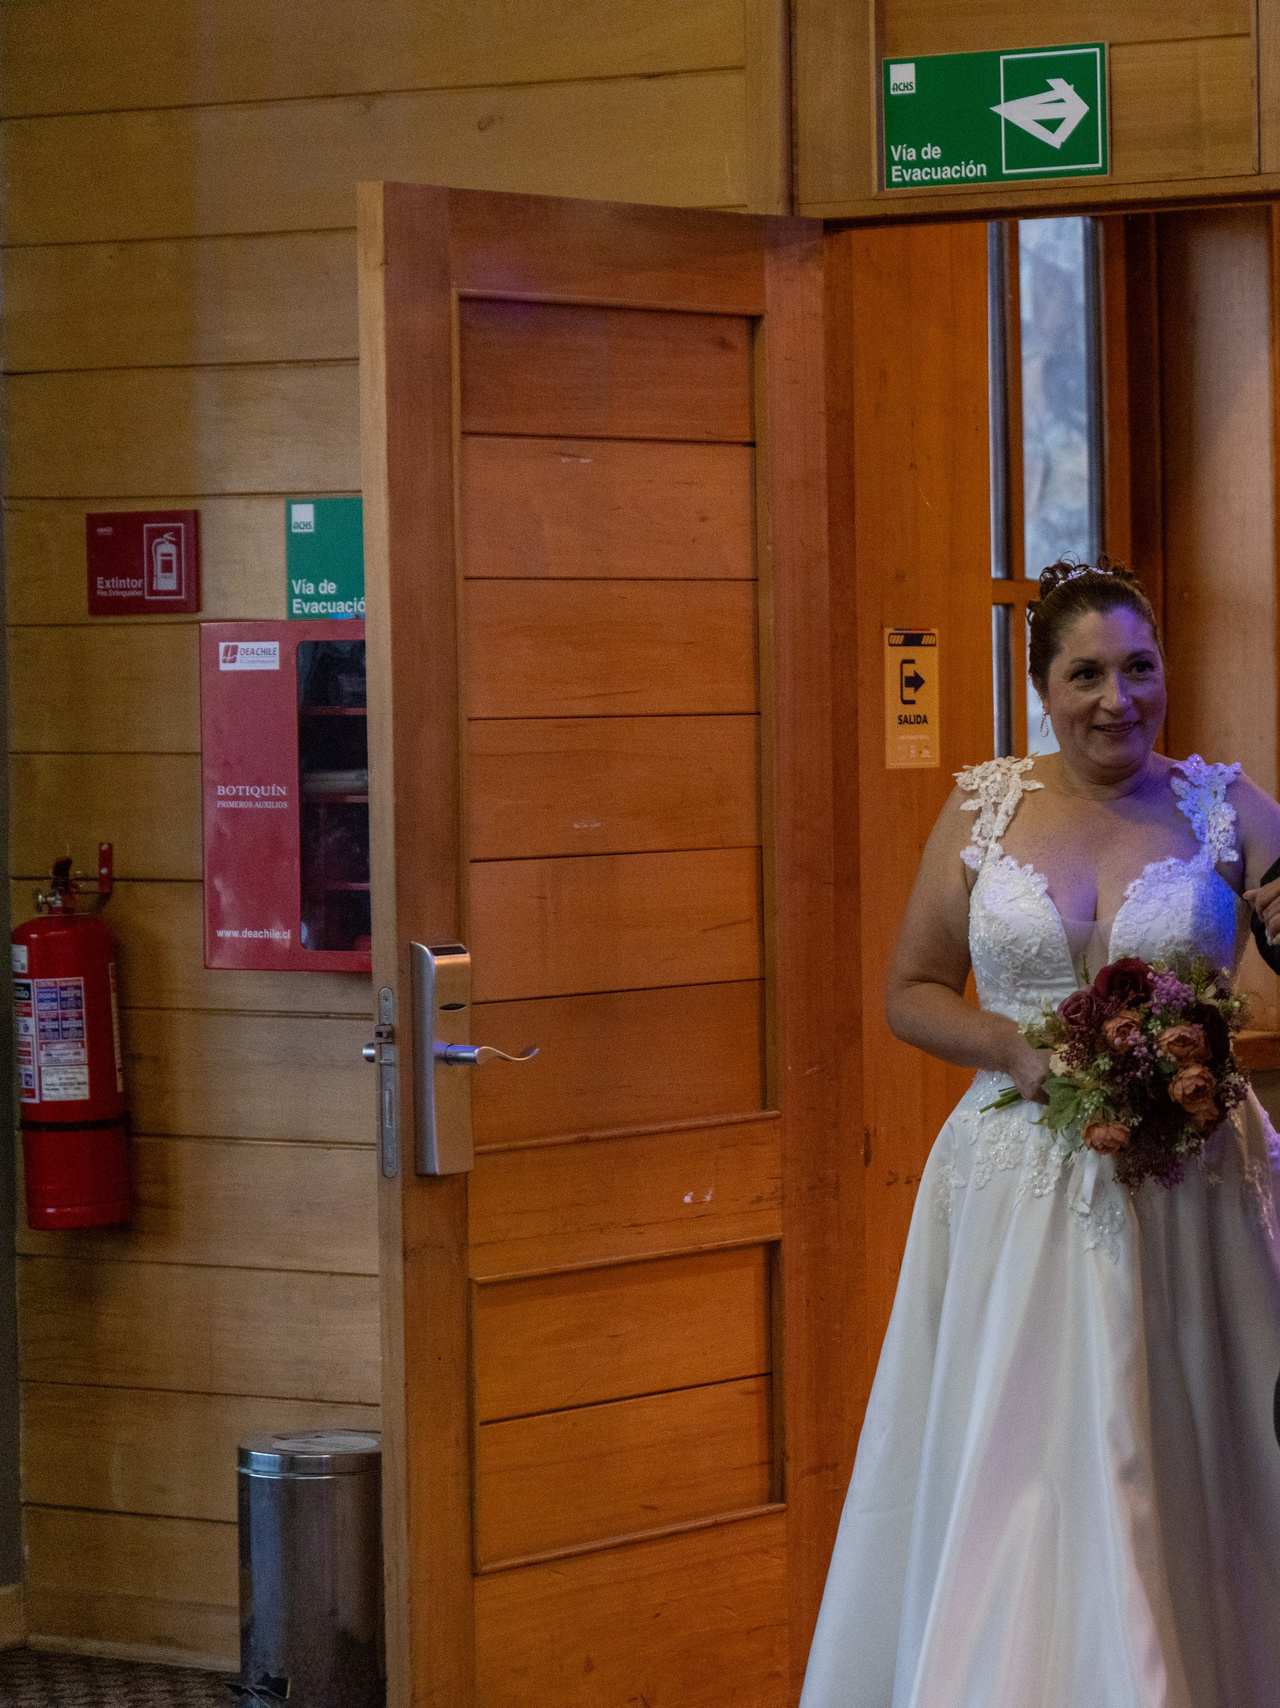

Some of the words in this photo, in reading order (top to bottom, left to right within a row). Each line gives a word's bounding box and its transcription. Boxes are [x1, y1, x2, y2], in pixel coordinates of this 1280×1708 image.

[892, 82, 913, 92] ACHS
[890, 144, 916, 161] Vía
[921, 143, 942, 159] de
[891, 161, 987, 182] Evacuación
[293, 521, 312, 530] ACHS
[97, 577, 143, 589] Extintor
[291, 579, 315, 595] Vía
[318, 579, 337, 594] de
[898, 714, 928, 725] SALIDA
[217, 784, 286, 798] BOTIQUÍN
[217, 800, 253, 808] PRIMEROS
[254, 801, 288, 809] AUXILIOS
[216, 928, 291, 939] www.deachile.cl
